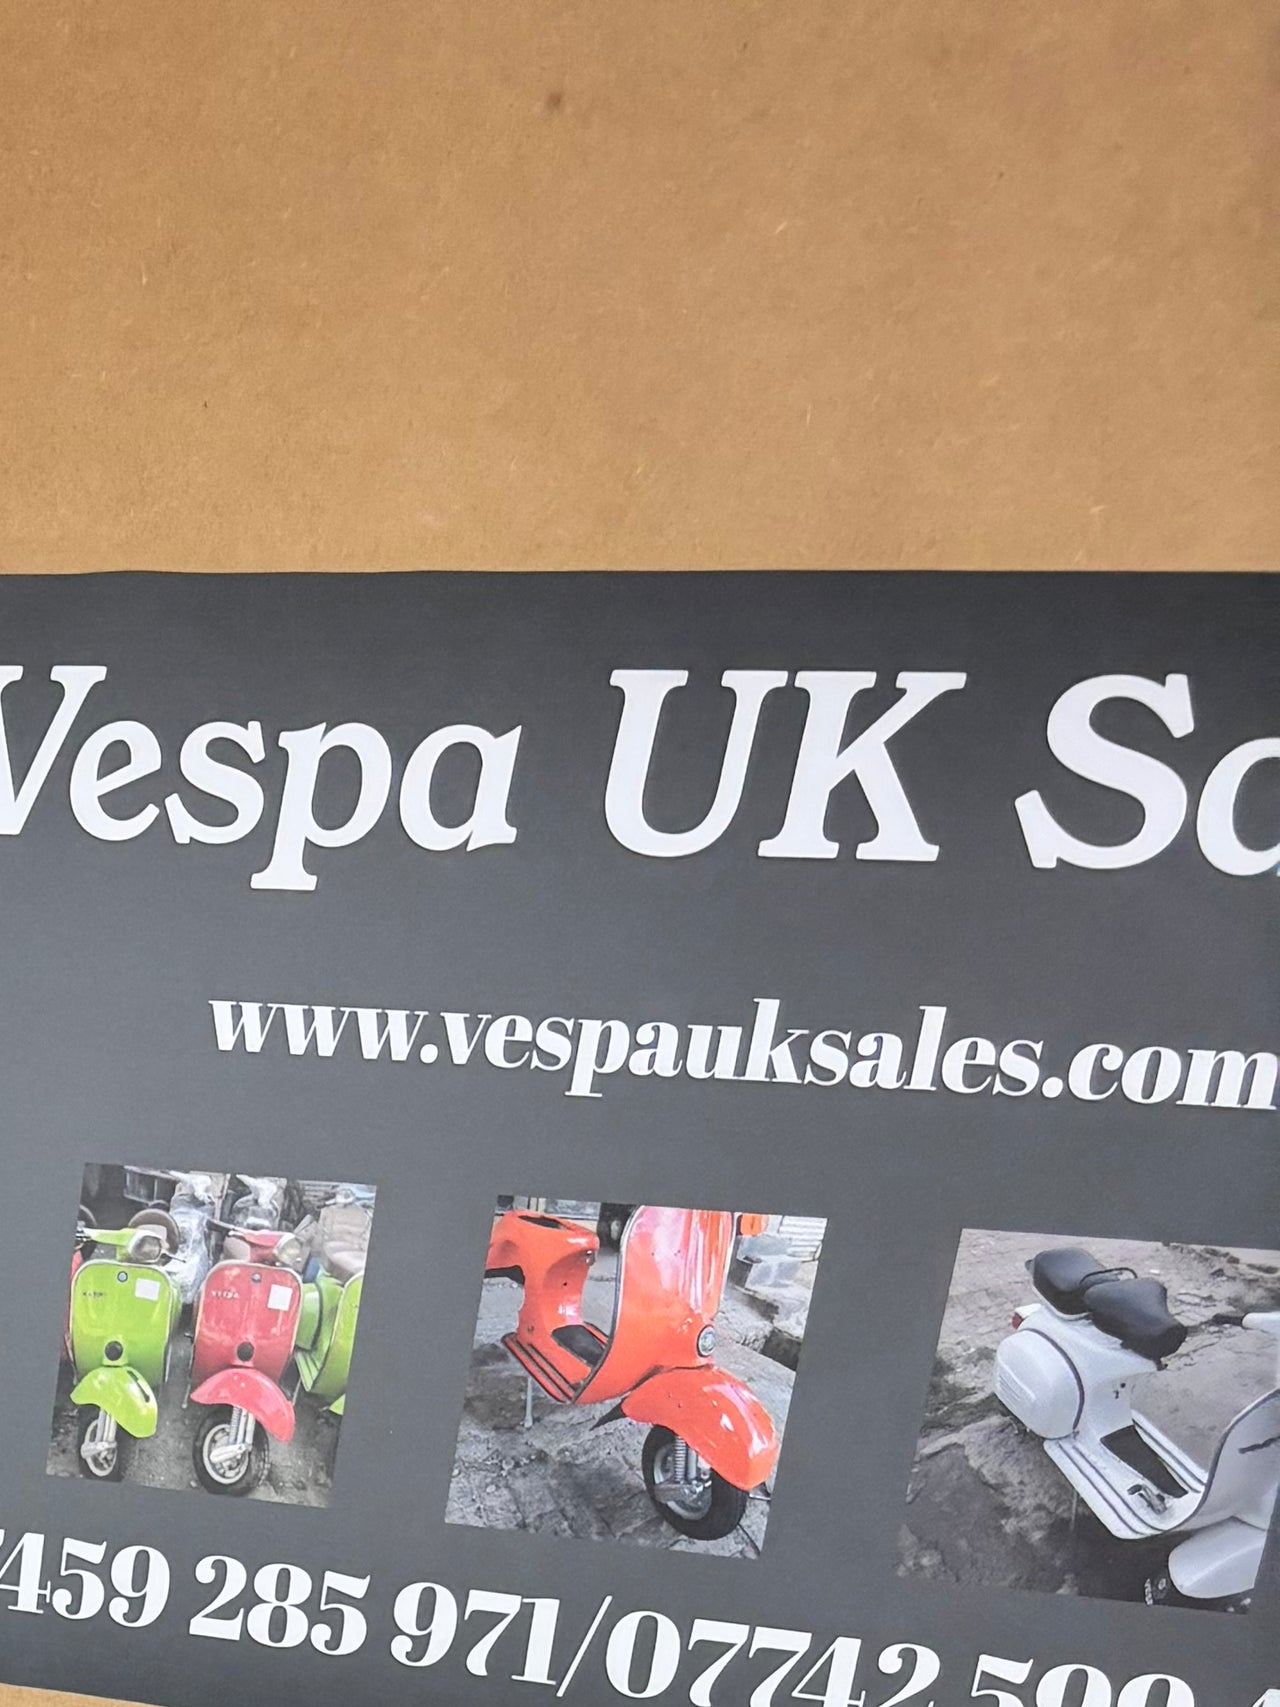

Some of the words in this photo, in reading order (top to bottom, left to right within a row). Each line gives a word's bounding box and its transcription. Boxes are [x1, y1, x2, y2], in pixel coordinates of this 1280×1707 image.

[605, 670, 966, 861] UK
[1014, 673, 1280, 878] Sa
[206, 997, 1279, 1110] www.vespauksales.com
[188, 1555, 371, 1656] 285
